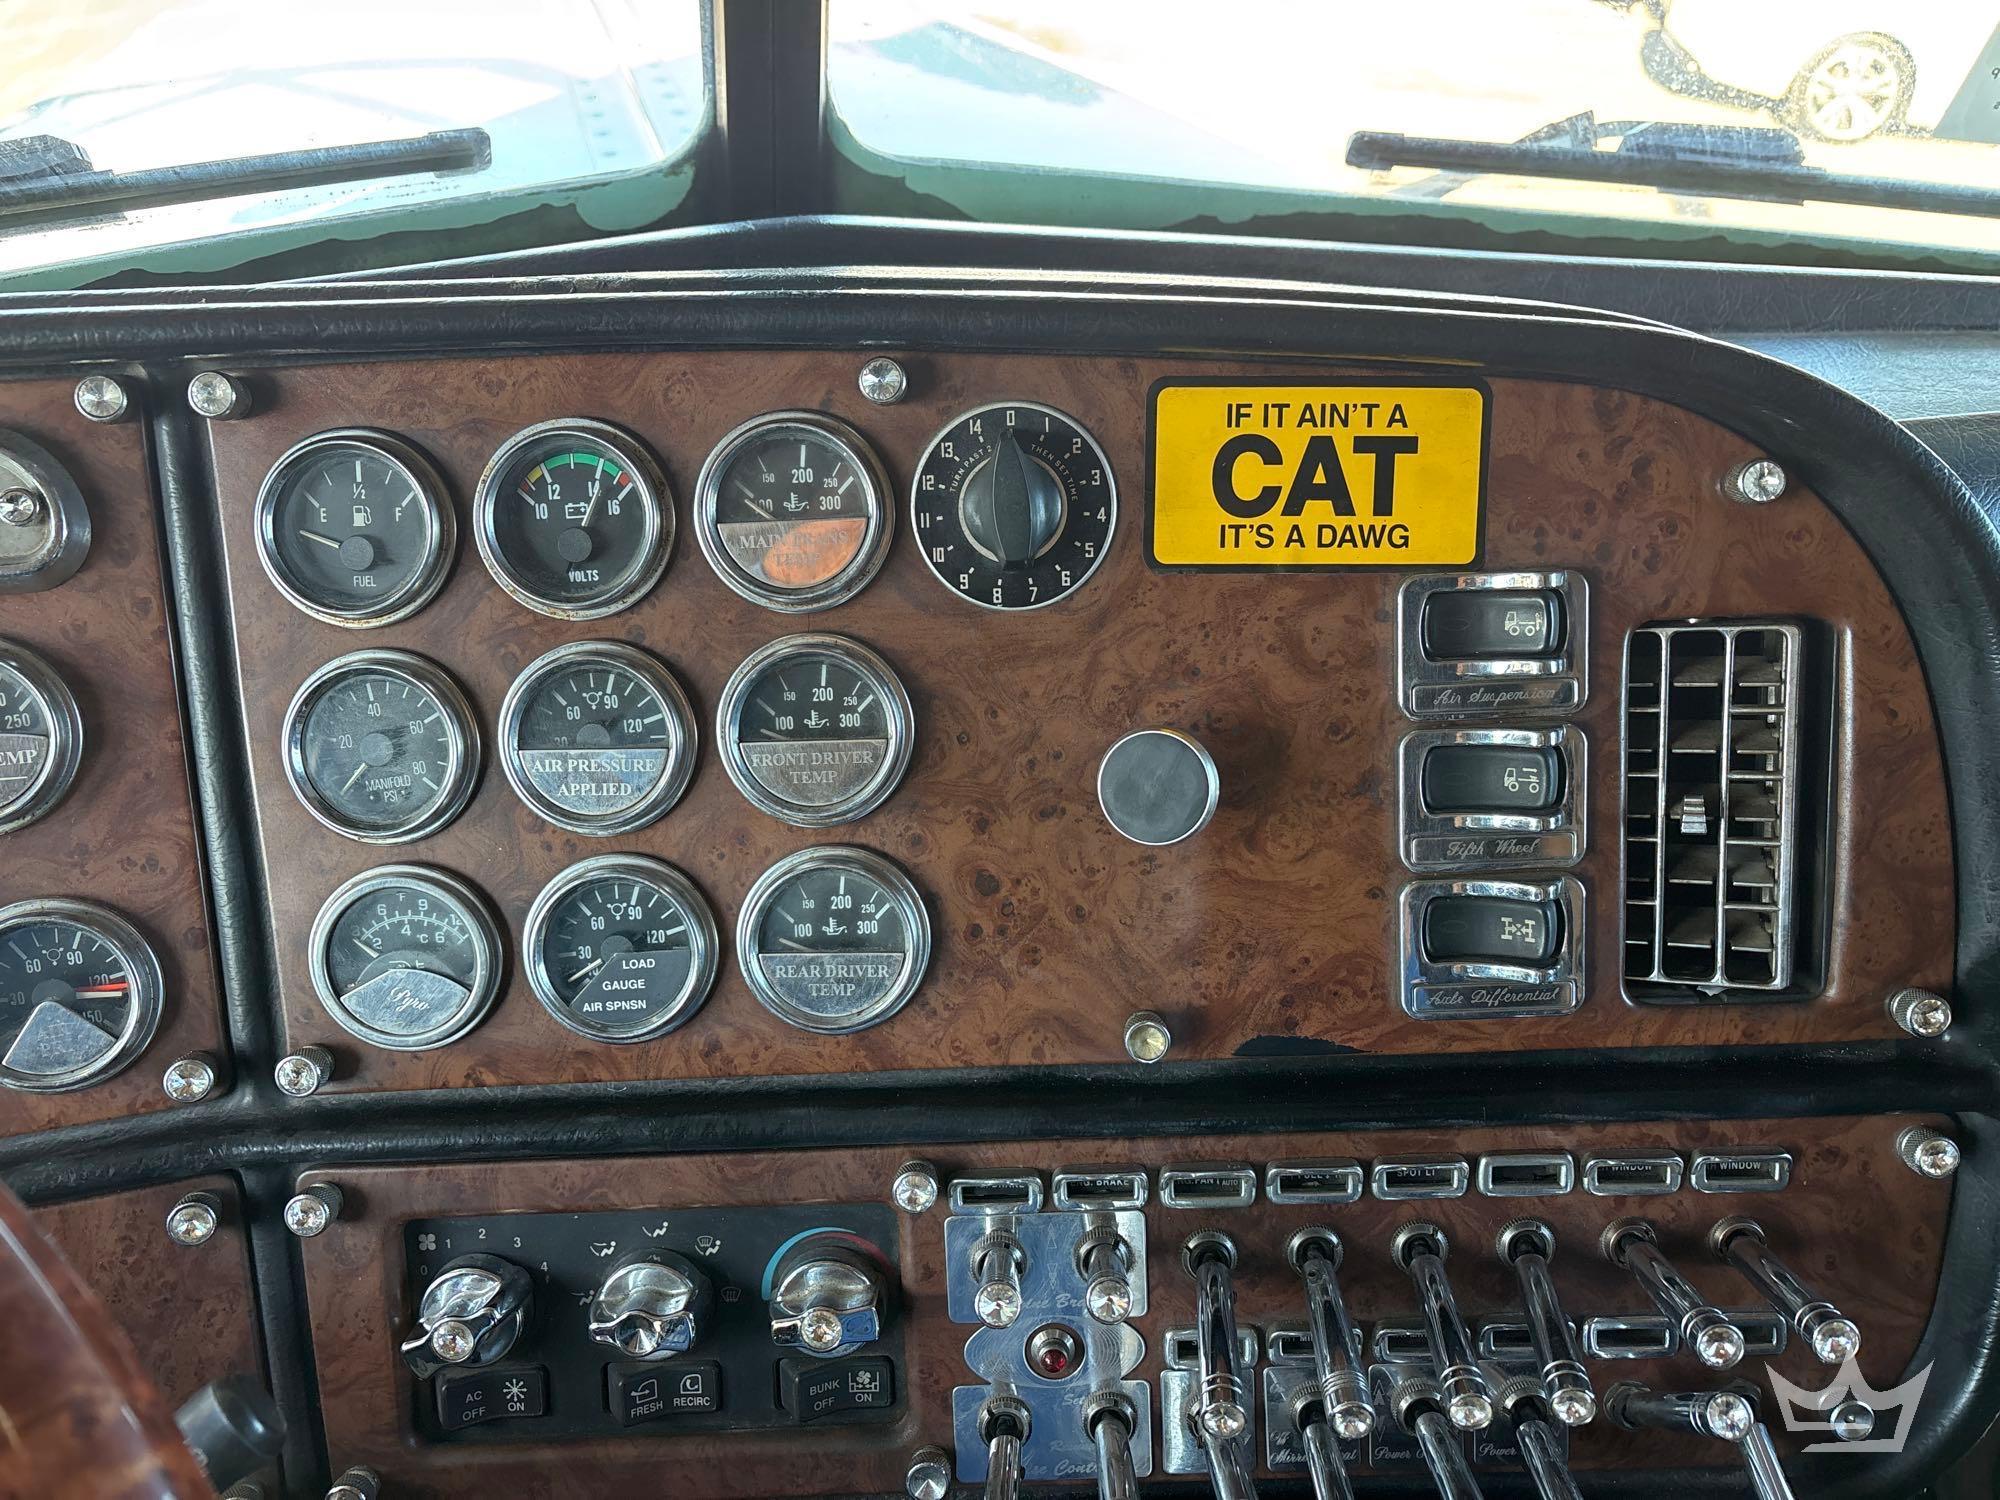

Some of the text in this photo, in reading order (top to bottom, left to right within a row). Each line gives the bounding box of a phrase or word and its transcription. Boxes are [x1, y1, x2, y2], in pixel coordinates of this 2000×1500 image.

[1006, 411, 1015, 426] 0
[1226, 403, 1408, 428] IF IT AIN'T A
[969, 419, 982, 434] 14
[1045, 417, 1049, 432] 1
[941, 442, 953, 457] 13
[1072, 438, 1081, 454] 2
[762, 473, 775, 483] 150
[791, 468, 813, 483] 200
[950, 469, 965, 492] TURN
[964, 449, 984, 468] PAST
[1031, 444, 1078, 501] THEN SET TIME
[1091, 470, 1100, 485] 3
[1211, 433, 1419, 518] CAT
[823, 478, 838, 488] 250
[923, 475, 934, 490] 12
[548, 484, 560, 500] 12
[608, 500, 620, 515] 16
[819, 496, 841, 510] 300
[321, 508, 327, 522] E
[395, 507, 402, 522] F
[535, 505, 548, 519] 10
[1097, 507, 1106, 522] 4
[921, 513, 930, 528] 11
[1219, 524, 1409, 549] IT'S A DAWG
[933, 547, 944, 562] 10
[1085, 543, 1094, 558] 5
[353, 576, 376, 587] FUEL
[568, 570, 599, 582] VOLTS
[960, 574, 969, 589] 9
[1062, 571, 1070, 586] 6
[993, 588, 1001, 603] 8
[1029, 587, 1038, 602] 7
[604, 695, 618, 709] 90
[783, 691, 796, 701] 150
[812, 687, 833, 702] 200
[843, 696, 858, 706] 250
[1433, 687, 1556, 707] Air Suspension
[367, 703, 381, 717] 40
[566, 706, 581, 720] 60
[4, 713, 31, 729] 250
[409, 720, 423, 734] 60
[623, 718, 643, 733] 120
[776, 716, 794, 730] 100
[839, 713, 861, 727] 300
[339, 735, 352, 749] 20
[0, 749, 38, 766] EMP
[751, 751, 874, 767] FRONT DRIVER
[413, 761, 426, 775] 80
[532, 758, 656, 773] AIR PRESSURE
[365, 775, 411, 792] MANIFOLD
[790, 770, 838, 784] TEMP
[558, 783, 632, 796] APPLIED
[1447, 838, 1541, 857] Fifth Wheel
[377, 904, 387, 916] 6
[418, 899, 428, 911] 9
[802, 899, 815, 909] 150
[831, 895, 852, 910] 200
[861, 904, 876, 913] 250
[628, 906, 642, 920] 90
[401, 924, 411, 936] 4
[591, 917, 605, 931] 60
[794, 923, 812, 938] 100
[857, 920, 878, 935] 300
[372, 937, 382, 950] 2
[435, 931, 445, 943] 6
[646, 930, 666, 943] 120
[66, 951, 83, 966] 90
[578, 945, 592, 959] 30
[26, 959, 42, 974] 60
[622, 958, 656, 970] LOAD
[775, 964, 890, 978] REAR DRIVER
[602, 979, 646, 991] GAUGE
[809, 983, 856, 996] TEMP
[10, 991, 25, 1006] 30
[389, 988, 430, 1012] Pyro
[1471, 986, 1560, 1007] Differential
[583, 1000, 647, 1012] AIR SPNSN
[1397, 1169, 1421, 1177] SPOT
[1720, 1161, 1761, 1170] WINDOW
[445, 1228, 549, 1272] 1 2 3 4
[420, 1265, 428, 1275] 0
[809, 1379, 841, 1396] BUNK
[465, 1391, 483, 1404] AC
[673, 1396, 711, 1407] RECIRC
[814, 1396, 835, 1411] OFF
[855, 1393, 872, 1402] ON
[462, 1406, 486, 1421] OFF
[507, 1402, 525, 1412] ON
[630, 1401, 663, 1418] FRESH
[1270, 1449, 1307, 1464] Mirr
[1374, 1446, 1411, 1460] Power
[1478, 1443, 1517, 1457] Power
[1054, 1459, 1098, 1476] Cont
